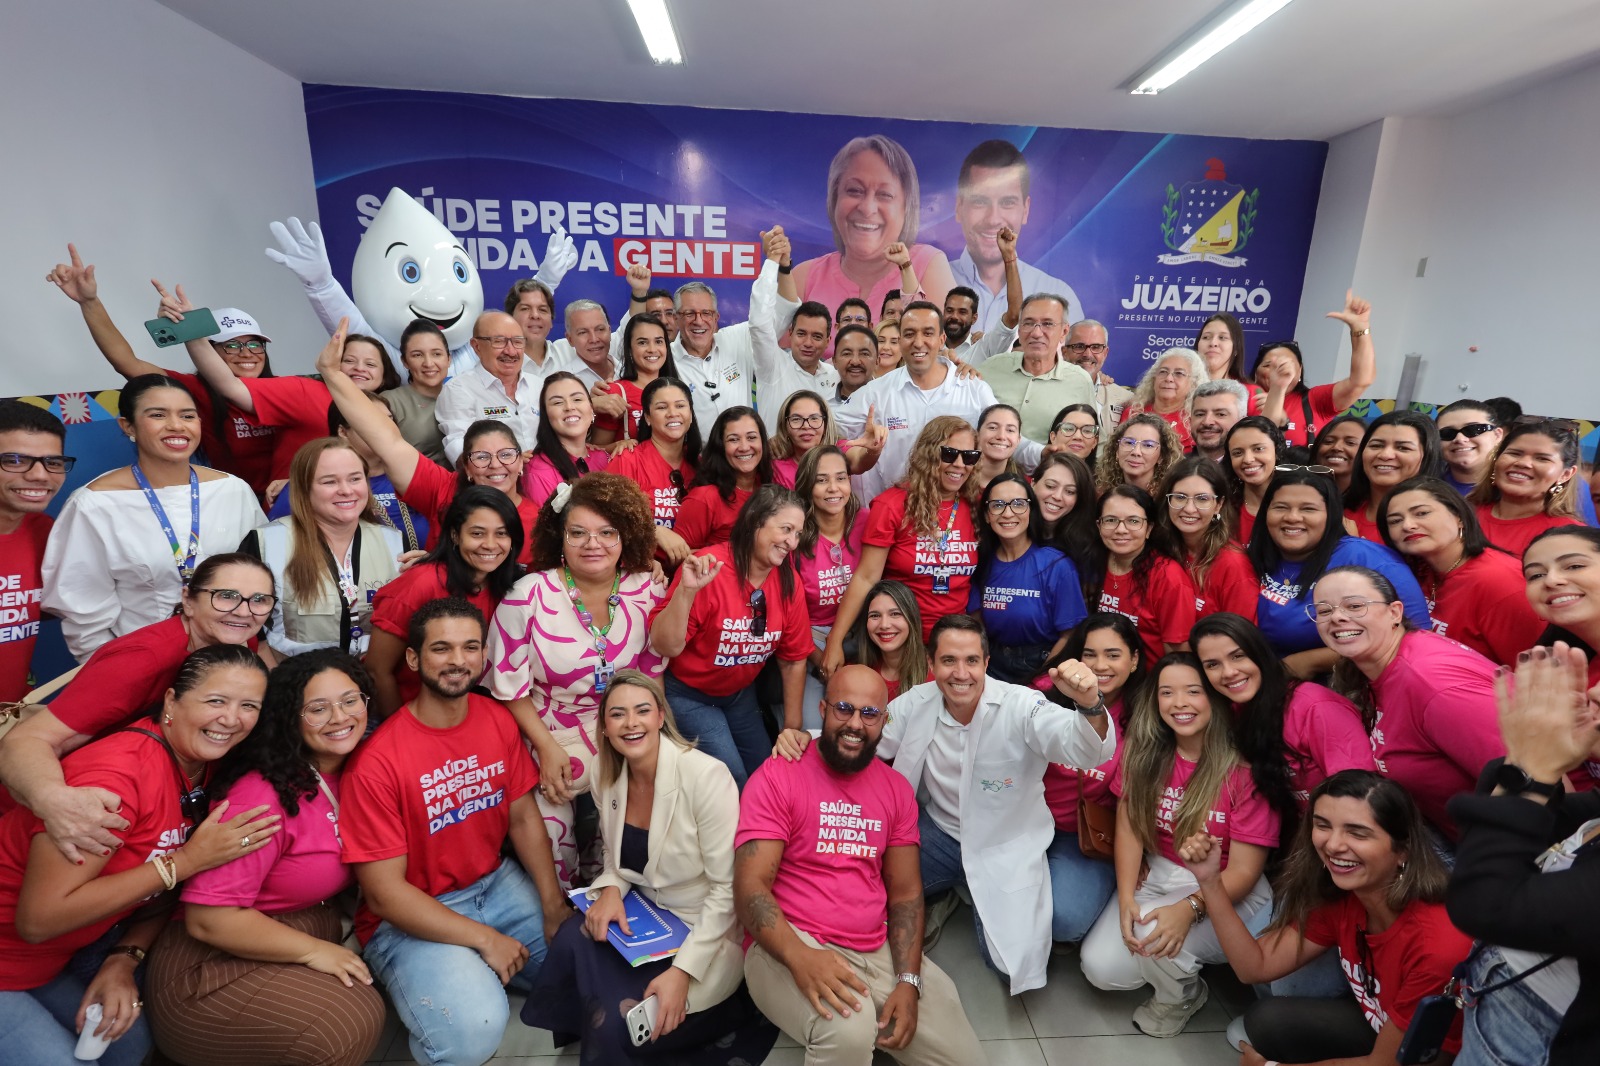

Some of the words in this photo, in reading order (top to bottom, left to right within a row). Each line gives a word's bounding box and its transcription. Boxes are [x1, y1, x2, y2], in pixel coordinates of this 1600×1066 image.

[355, 186, 502, 233] SÚDE
[511, 199, 727, 238] PRESENTE
[462, 236, 540, 271] IDA
[618, 240, 755, 276] GENTE
[1134, 275, 1265, 286] PREFEITURA
[1121, 283, 1271, 313] JUAZEIRO
[1119, 314, 1164, 322] PRESENTE
[1168, 315, 1181, 323] NO
[1184, 315, 1208, 323] FUTU
[1239, 317, 1268, 325] GENTE
[1147, 334, 1197, 347] Secreta
[655, 508, 675, 517] NA
[655, 519, 672, 529] DA
[915, 552, 937, 564] NA
[939, 553, 971, 564] VIDA
[914, 564, 934, 575] DA
[820, 588, 836, 598] NA
[996, 587, 1041, 598] PRESENTE
[819, 597, 835, 606] DA
[0, 621, 40, 643] ENTE
[718, 643, 739, 654] NA
[742, 643, 772, 654] VIDA
[714, 654, 735, 666] DA
[420, 754, 479, 788] SAÚDE
[423, 760, 505, 805] PRESENTE
[427, 797, 455, 820] NA
[456, 781, 492, 804] VIDA
[429, 812, 455, 834] DA
[457, 788, 503, 820] GENTE
[820, 800, 861, 816] SAÚDE
[820, 814, 882, 832] PRESENTE
[818, 828, 837, 840] NA
[838, 829, 867, 843] VIDA
[816, 841, 835, 854] DA
[837, 842, 878, 858] GENTE
